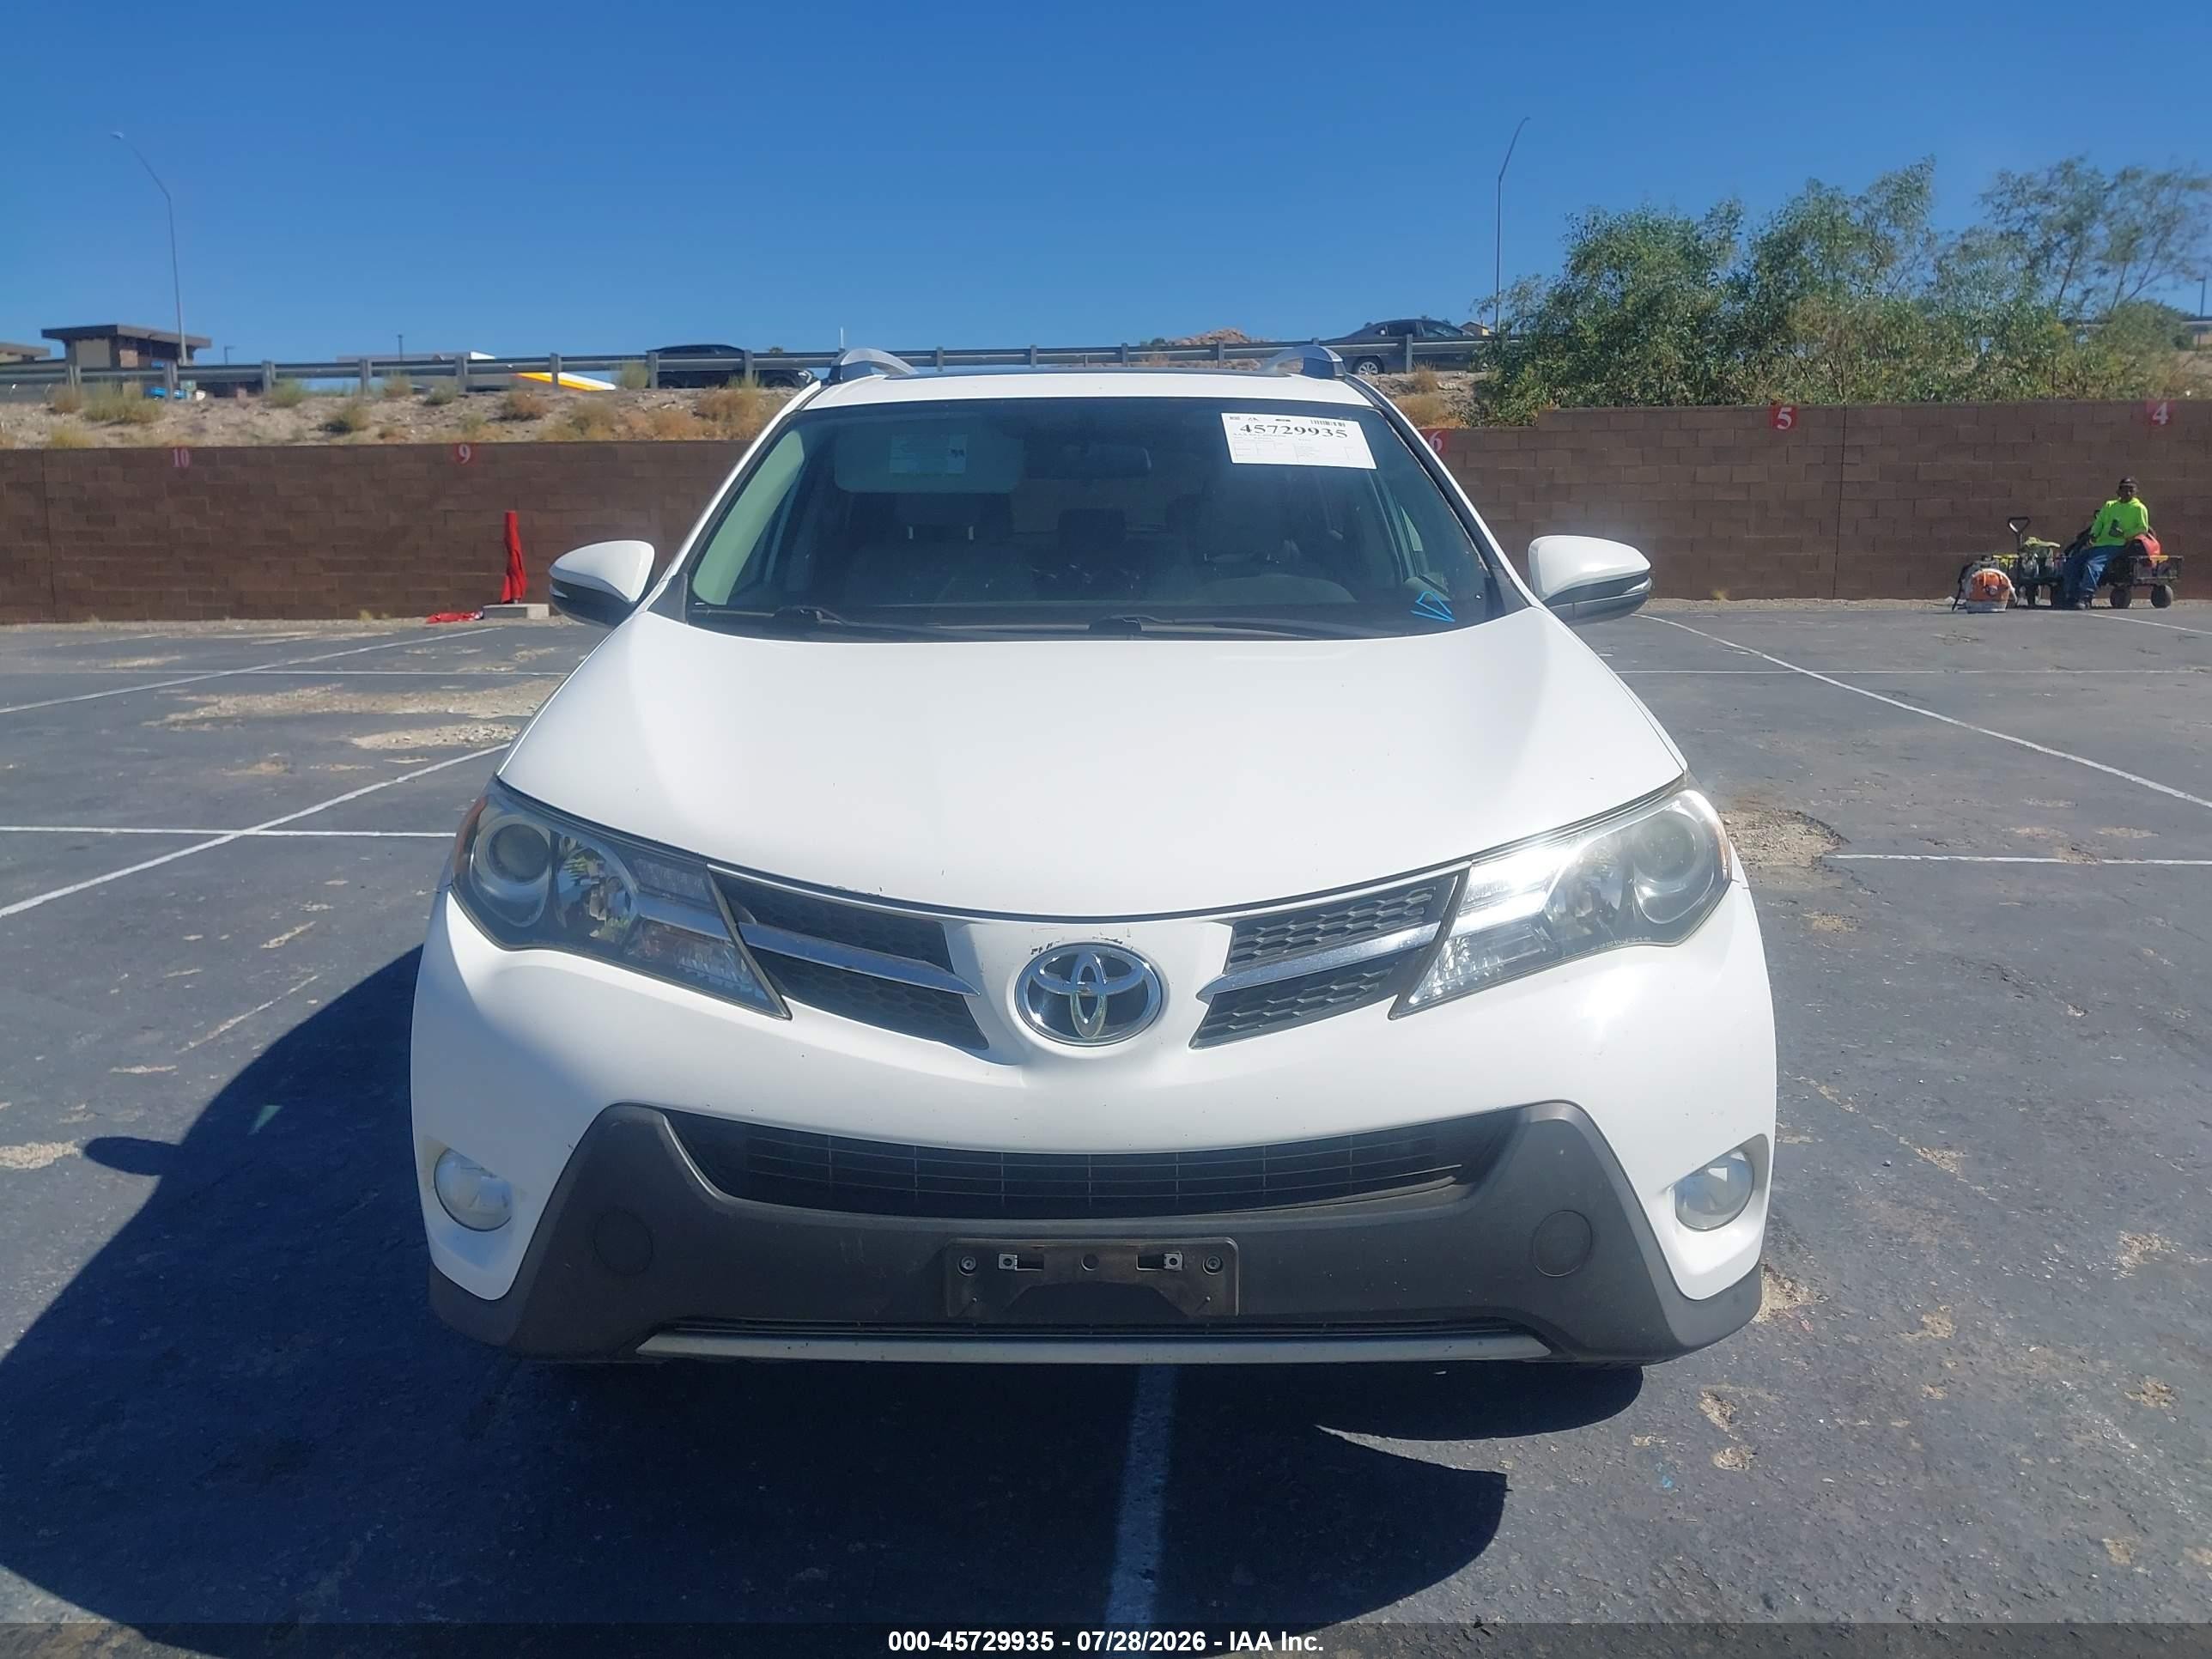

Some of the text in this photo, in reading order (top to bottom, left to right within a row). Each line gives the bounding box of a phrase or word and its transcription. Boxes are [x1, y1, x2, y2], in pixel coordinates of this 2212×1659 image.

[1778, 407, 1792, 429] 5
[2152, 402, 2169, 425] 4
[1239, 424, 1348, 439] 45729935
[1428, 429, 1443, 453] 6
[173, 447, 190, 468] 10
[459, 444, 471, 465] 9
